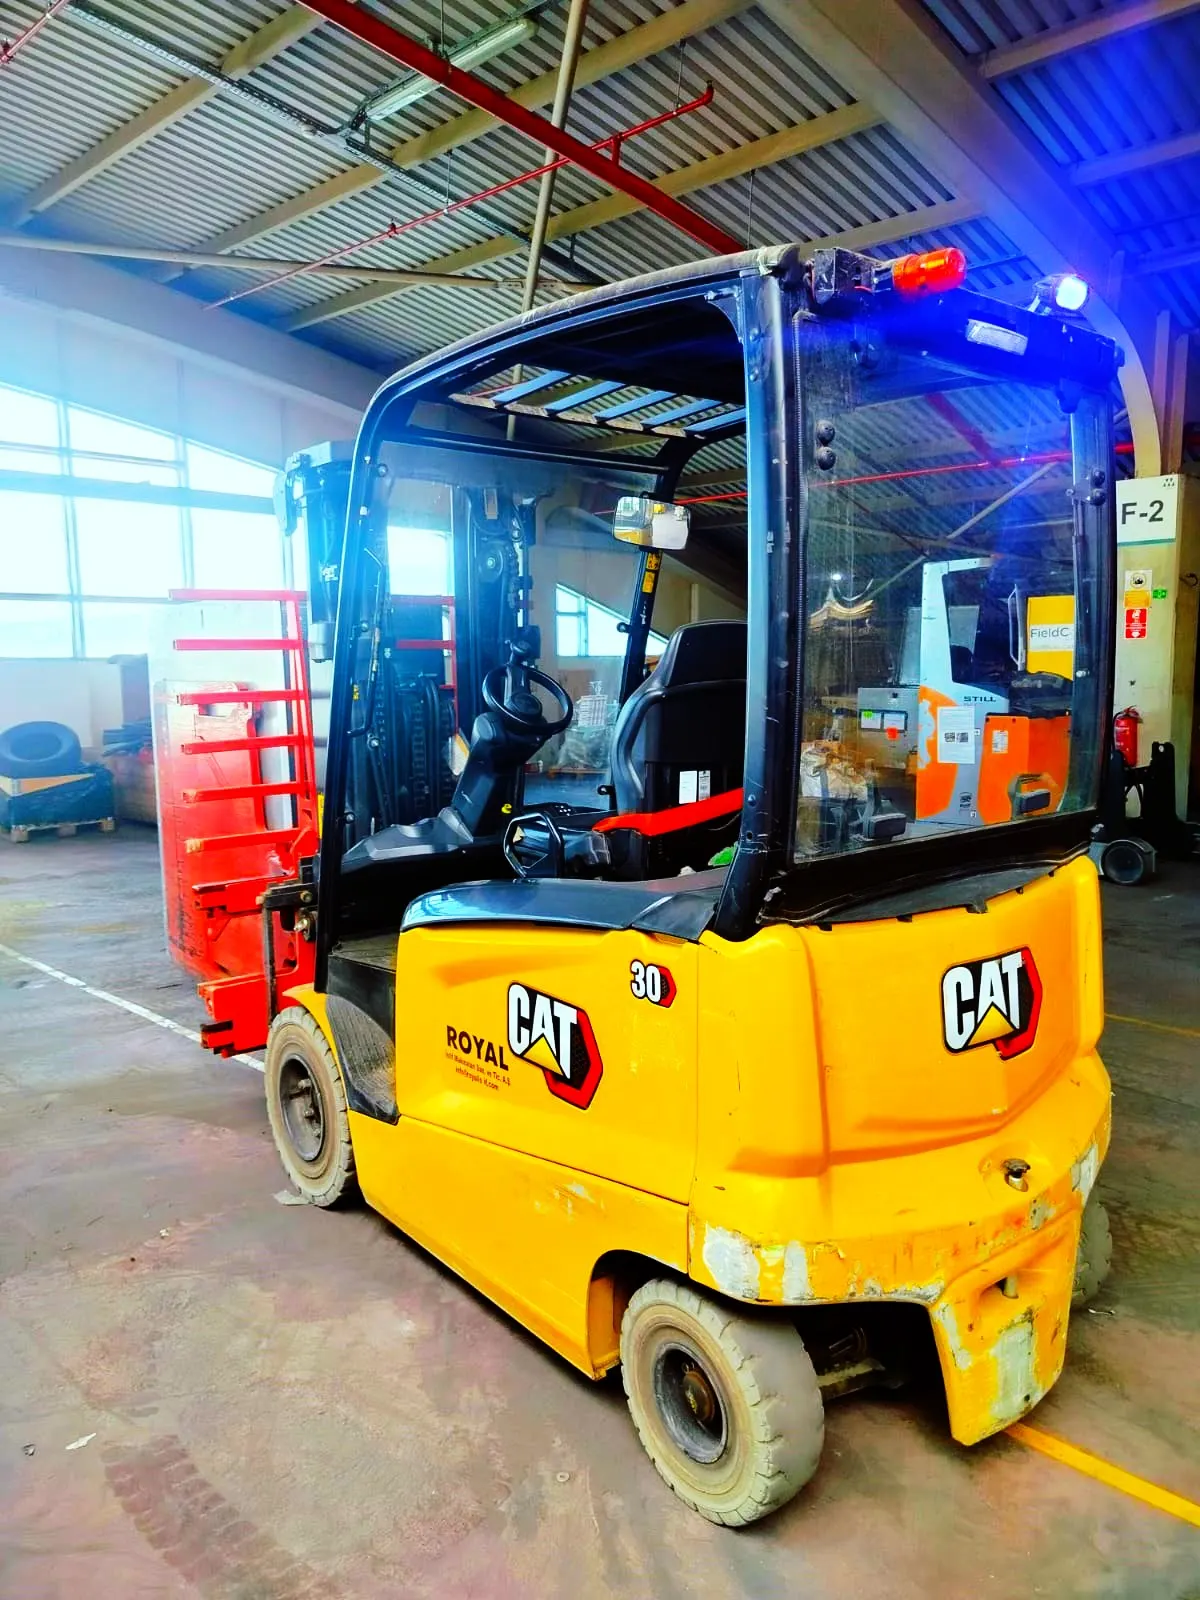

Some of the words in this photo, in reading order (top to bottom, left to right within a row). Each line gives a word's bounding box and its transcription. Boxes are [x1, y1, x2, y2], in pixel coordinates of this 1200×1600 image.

[1121, 499, 1164, 525] F-2
[631, 960, 661, 1003] 30
[942, 951, 1023, 1050] CAT
[446, 1025, 509, 1071] ROYAL
[508, 984, 578, 1080] CAT
